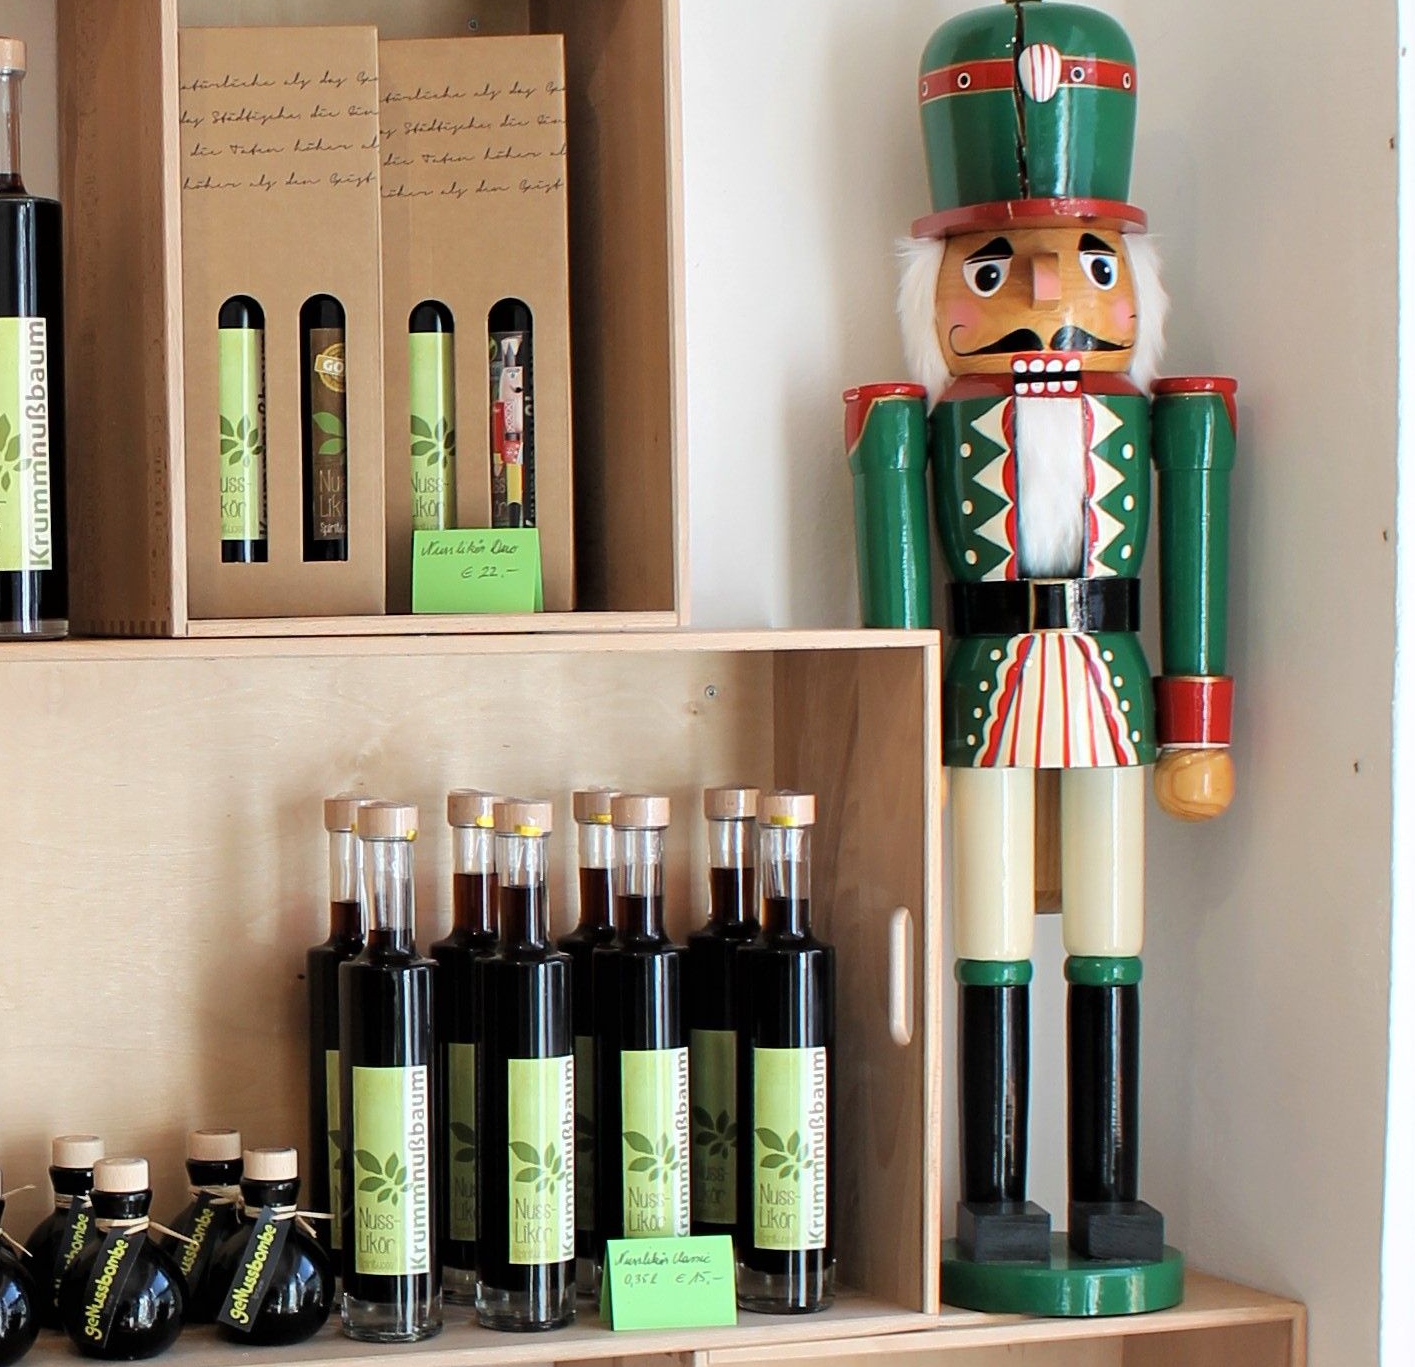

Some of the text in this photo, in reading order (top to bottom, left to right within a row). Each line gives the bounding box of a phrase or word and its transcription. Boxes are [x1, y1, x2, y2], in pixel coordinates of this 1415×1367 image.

[322, 358, 345, 374] GO
[25, 321, 49, 566] Krummnußbaum
[461, 567, 473, 578] €
[809, 1051, 824, 1244] Krummnußbaum
[409, 1069, 426, 1270] Krummnußbaum
[628, 1186, 670, 1209] Nuss-
[759, 1183, 800, 1205] Nuss-
[358, 1207, 401, 1230] Nuss-
[515, 1198, 557, 1220] Nuss-
[759, 1207, 796, 1229] Likör
[628, 1210, 666, 1232] Likör
[359, 1230, 396, 1254] Likör
[230, 1224, 277, 1324] geNussbombe
